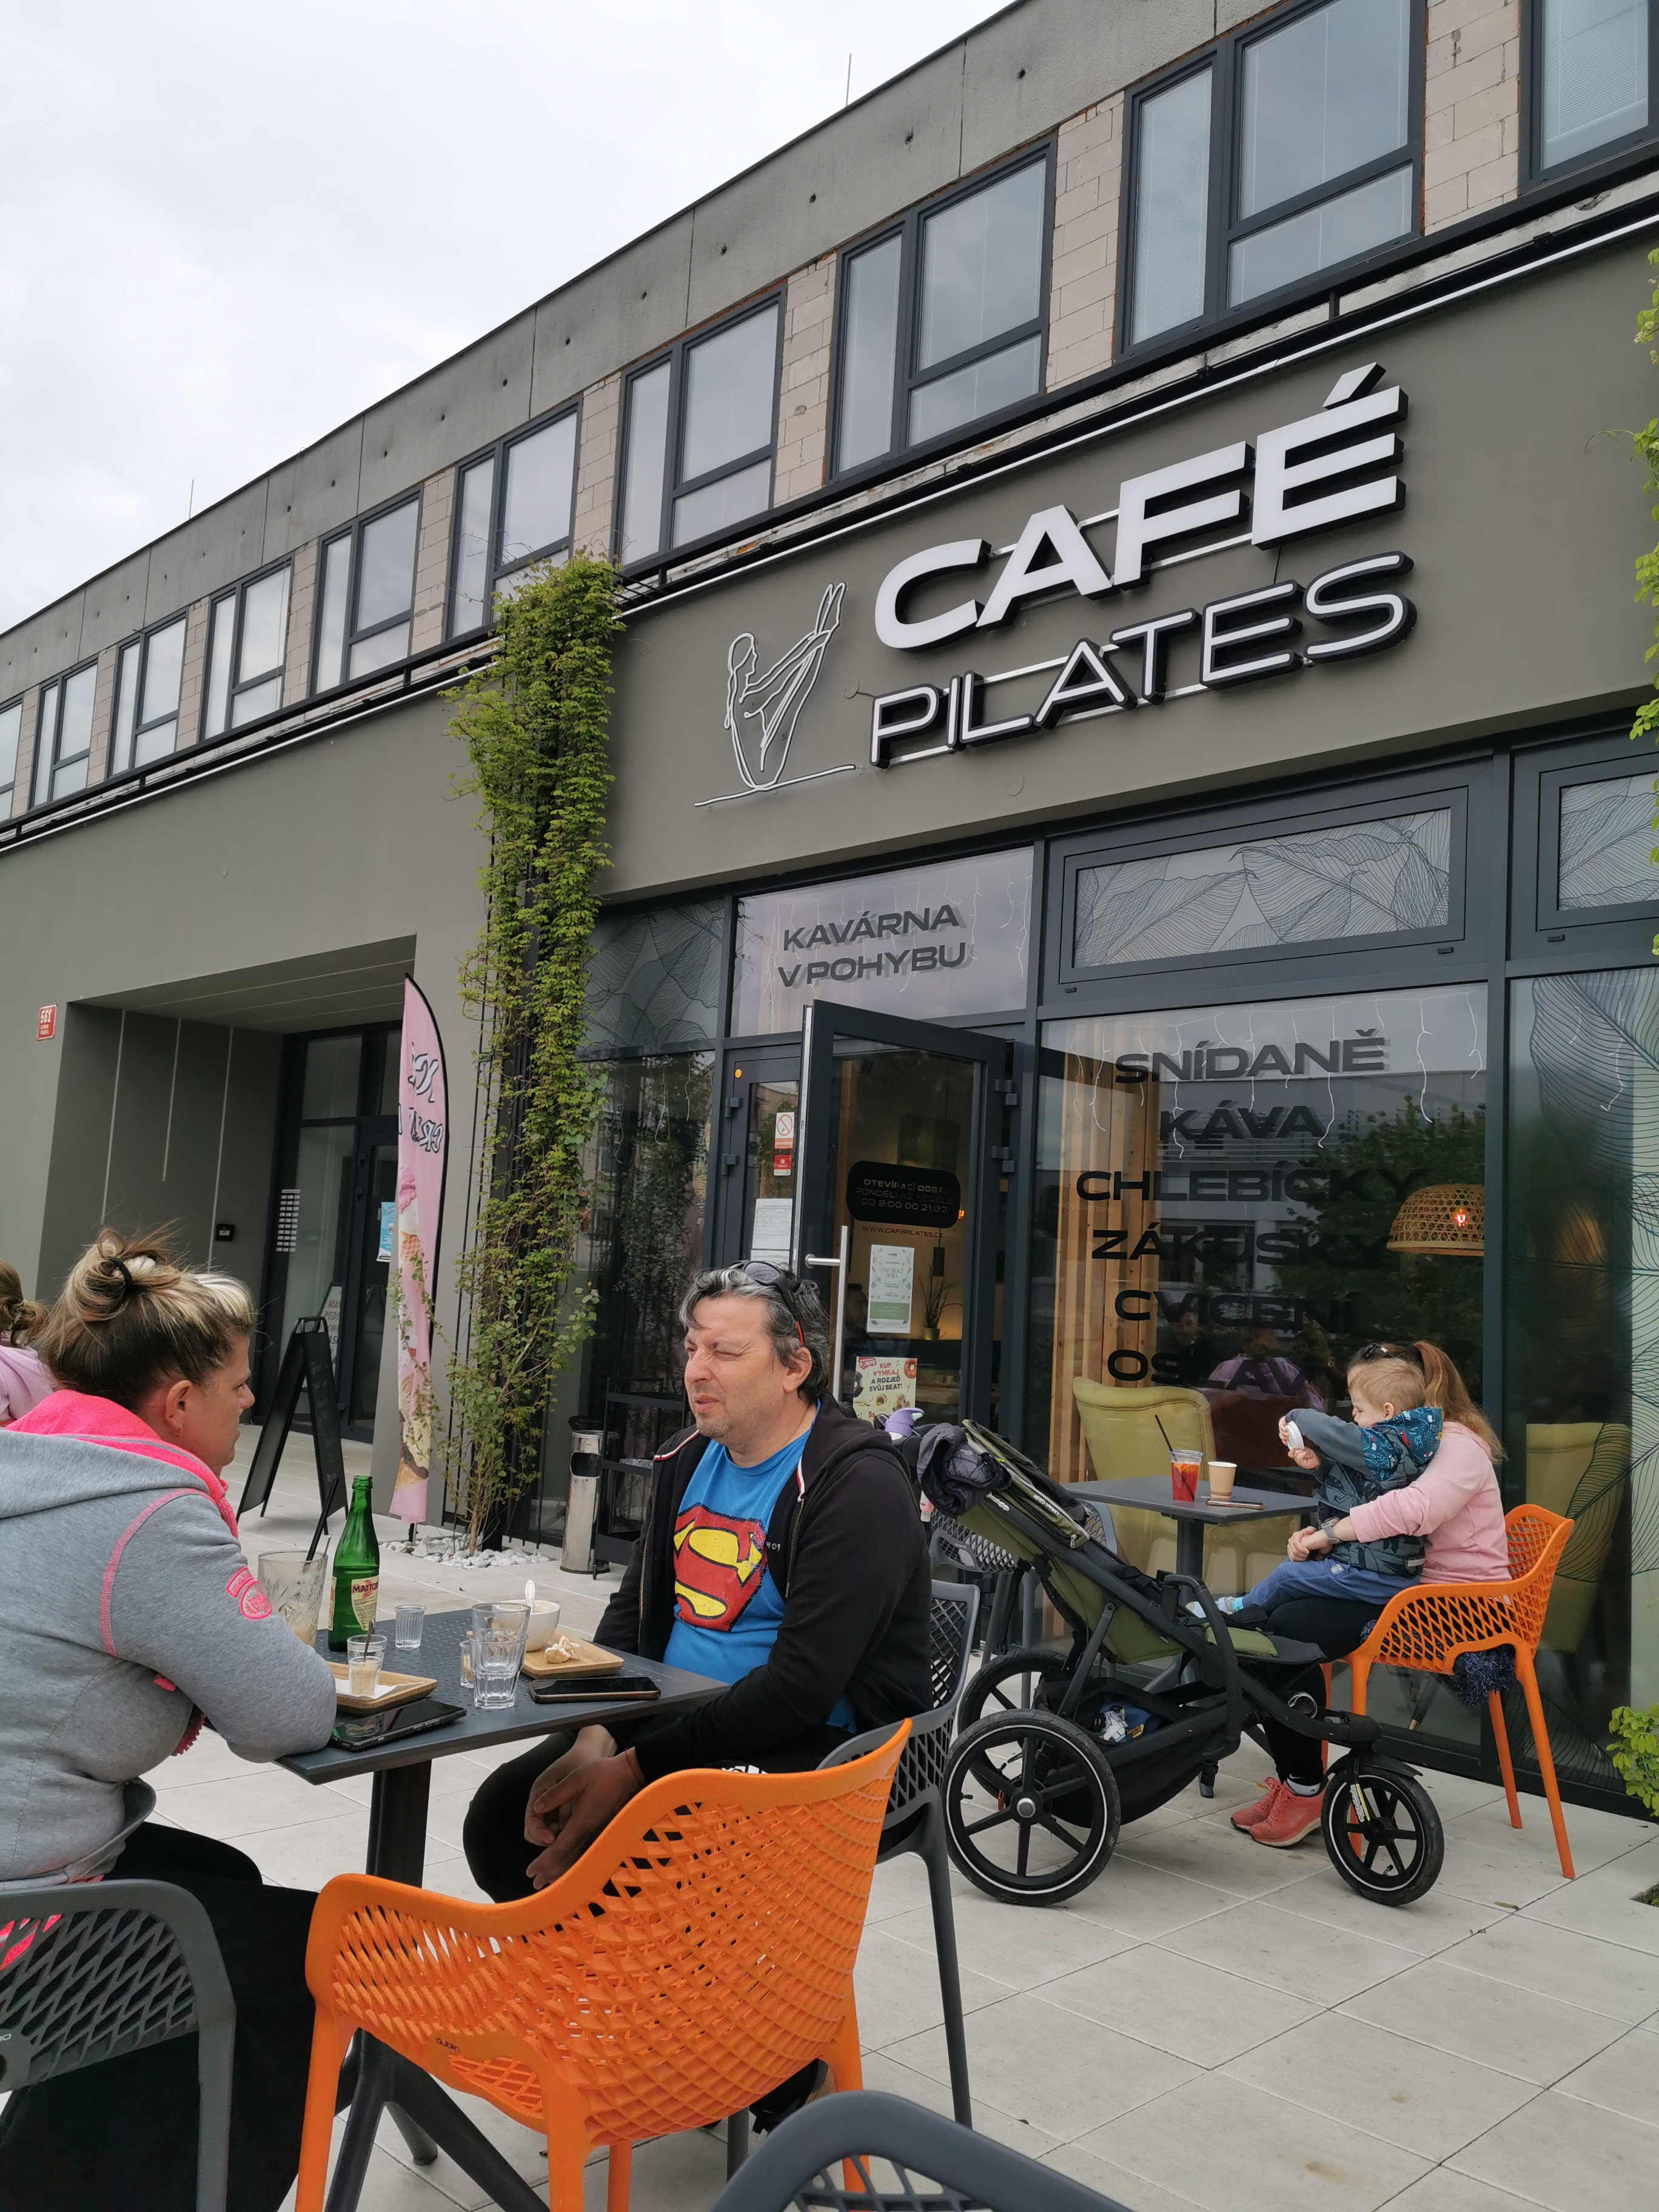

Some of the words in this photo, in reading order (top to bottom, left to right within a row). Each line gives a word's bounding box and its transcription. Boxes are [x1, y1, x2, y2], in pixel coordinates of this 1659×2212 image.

[874, 363, 1408, 651] CAFÉ
[869, 551, 1416, 768] PILATES
[783, 904, 960, 951] KAVÁRNA
[777, 964, 801, 987] V
[806, 942, 967, 985] POHYBU
[40, 1009, 52, 1024] 561
[1114, 1028, 1386, 1084] SNÍDANĚ
[1159, 1099, 1326, 1141] KÁVA
[863, 1178, 916, 1191] OTEVÍRACÍ
[1076, 1161, 1424, 1203] CHLEBÍČKY
[860, 1198, 876, 1206] OD
[878, 1199, 902, 1209] 8:00
[905, 1202, 919, 1211] DO
[921, 1204, 948, 1213] 21:00
[862, 1225, 945, 1239] WWW.CAFEPILATES.CZ
[1091, 1222, 1392, 1269] ZÁKUSKY
[1114, 1286, 1361, 1335] CVIČENÍ
[1033, 1493, 1047, 1505] Glide
[1045, 1501, 1061, 1516] Urban
